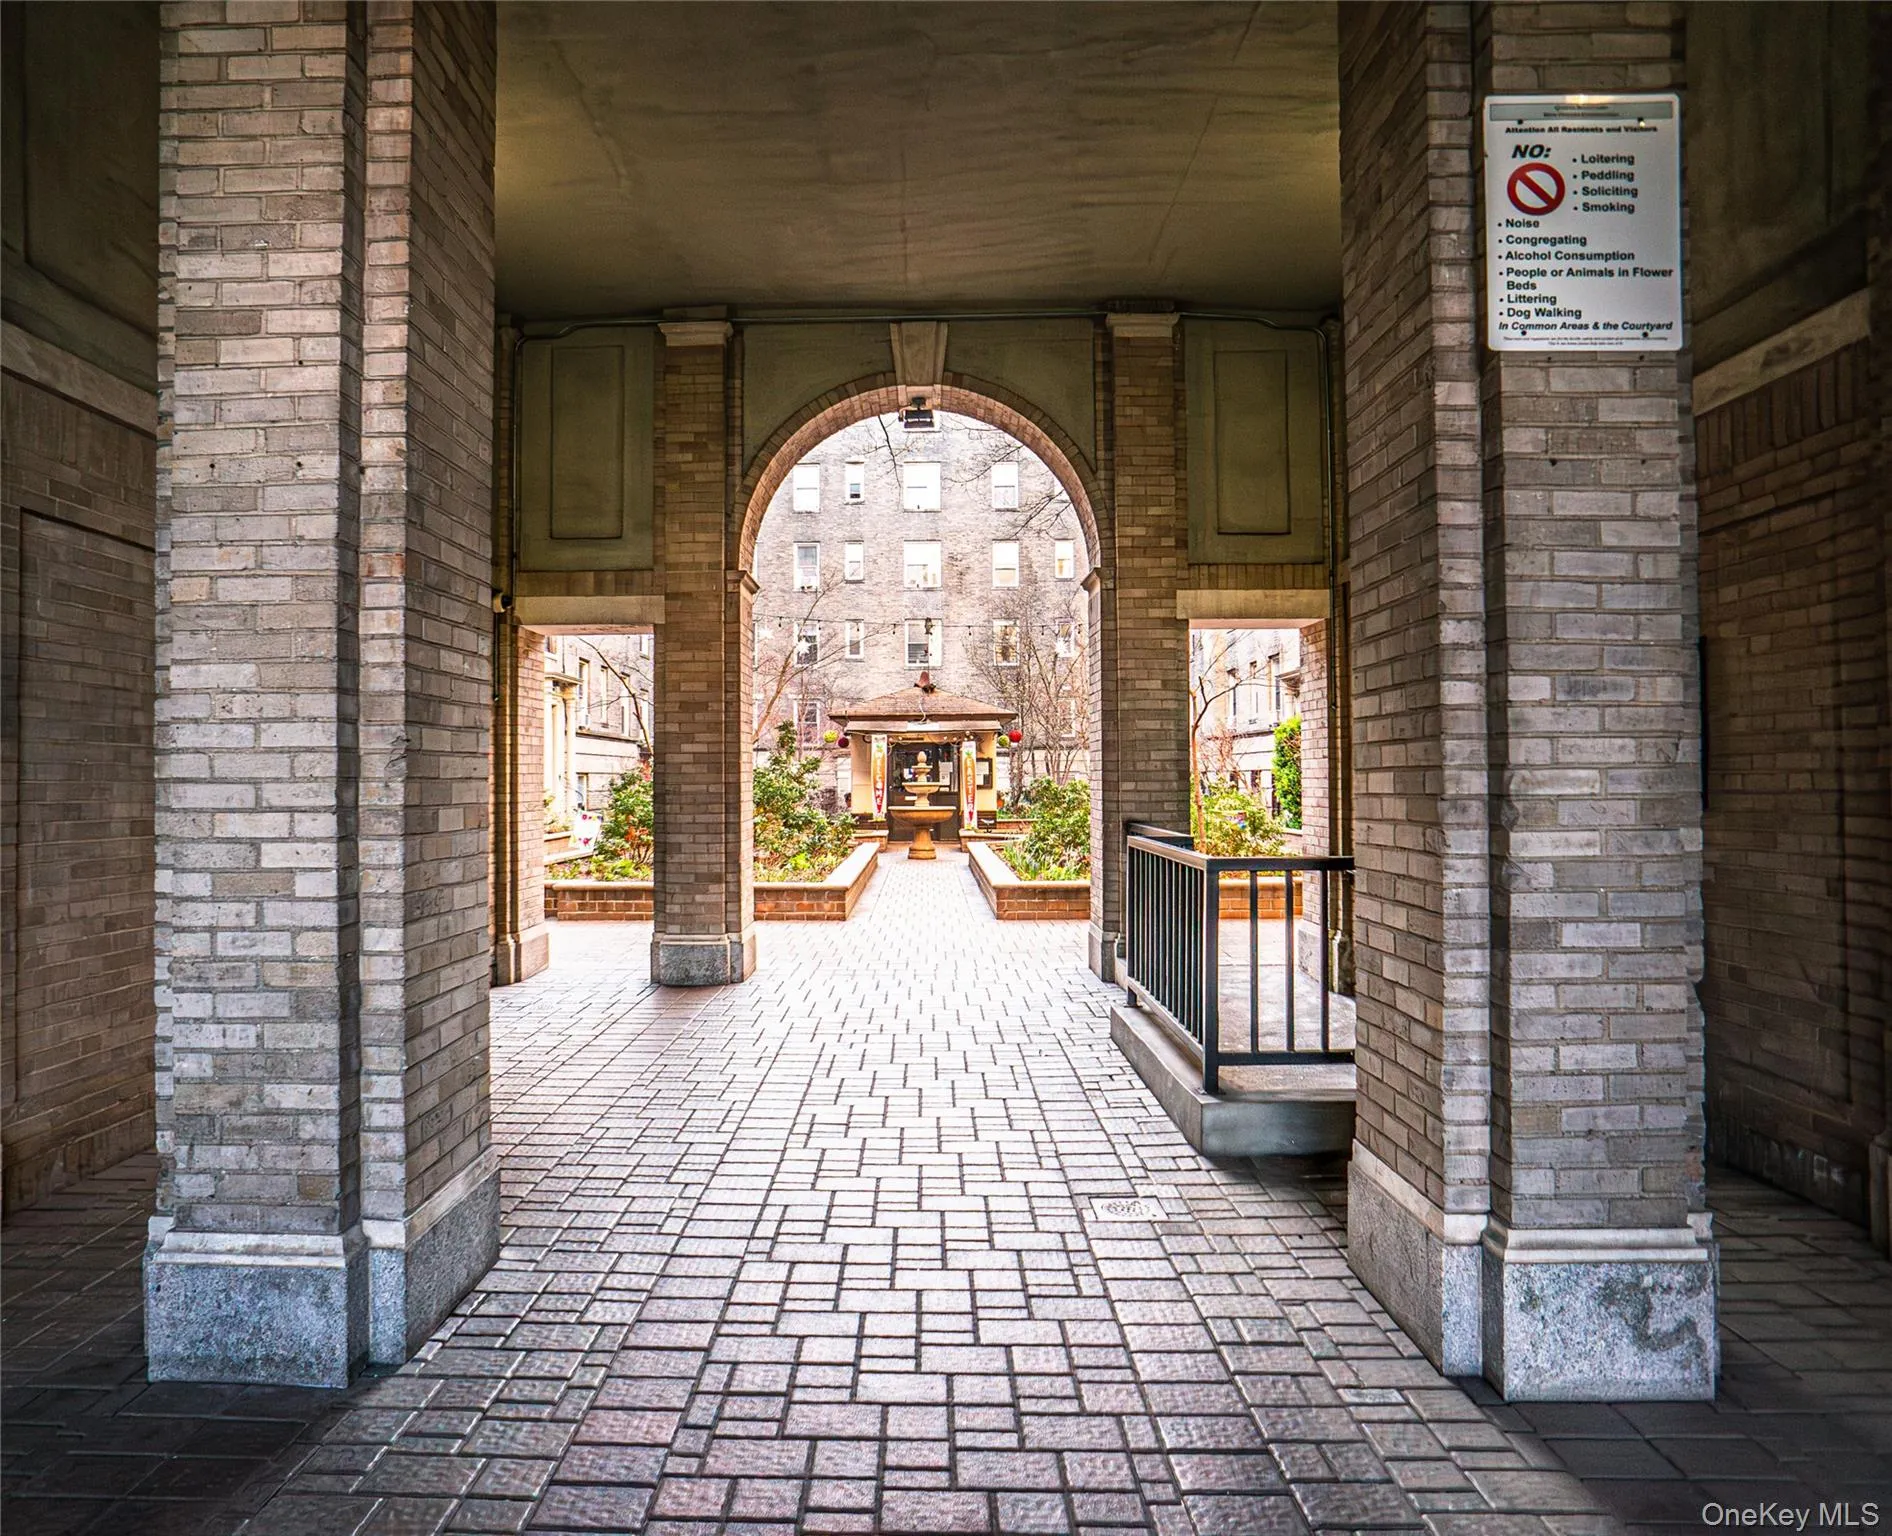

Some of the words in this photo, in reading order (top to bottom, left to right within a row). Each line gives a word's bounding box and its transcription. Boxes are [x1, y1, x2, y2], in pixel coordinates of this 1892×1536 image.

[1512, 144, 1551, 158] NO:
[1581, 155, 1635, 165] Loitering
[1581, 170, 1634, 182] Peddling
[1582, 186, 1638, 197] Soliciting
[1582, 203, 1635, 213] Smoking
[1506, 219, 1539, 228] Noise
[1506, 235, 1587, 246] Congregating
[1505, 251, 1551, 260] Alcohol
[1555, 251, 1635, 262] Consumption
[1506, 268, 1547, 279] People
[1567, 268, 1614, 277] Animals
[1618, 268, 1629, 277] in
[1633, 268, 1673, 277] Flower
[1507, 281, 1536, 290] Beds
[1508, 294, 1557, 305] Littering
[1507, 308, 1530, 319] Dog
[1534, 308, 1582, 319] Walking
[1499, 321, 1508, 330] In
[1512, 322, 1557, 330] Common
[1560, 322, 1589, 330] Areas
[1592, 322, 1600, 330] &
[1603, 322, 1618, 330] the
[1621, 321, 1672, 332] Courtyard
[967, 758, 975, 812] EASTER
